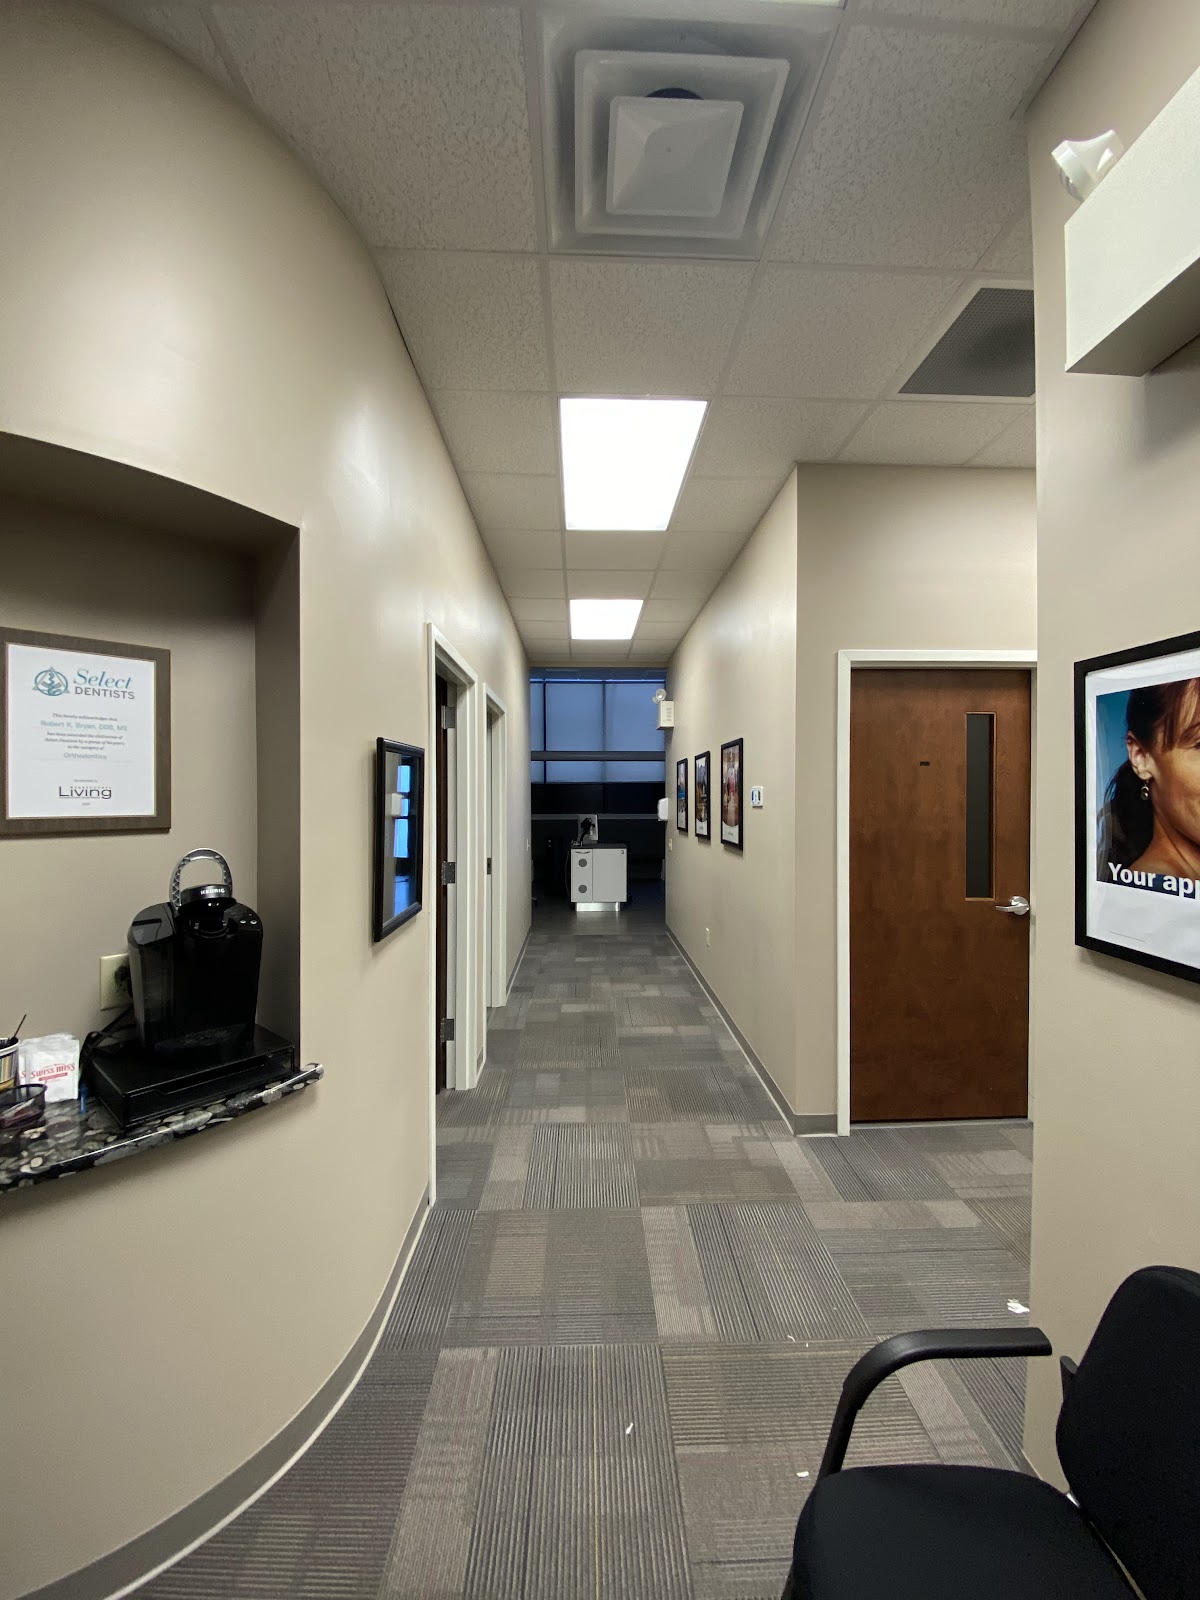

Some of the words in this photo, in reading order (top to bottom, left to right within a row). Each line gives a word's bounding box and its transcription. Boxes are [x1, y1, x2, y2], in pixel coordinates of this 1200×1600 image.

[73, 668, 131, 689] Select
[74, 686, 135, 700] DENTISTS
[63, 752, 108, 760] Orthodontics
[59, 786, 112, 799] Living
[1107, 861, 1156, 888] Your
[200, 888, 225, 896] KEURIG
